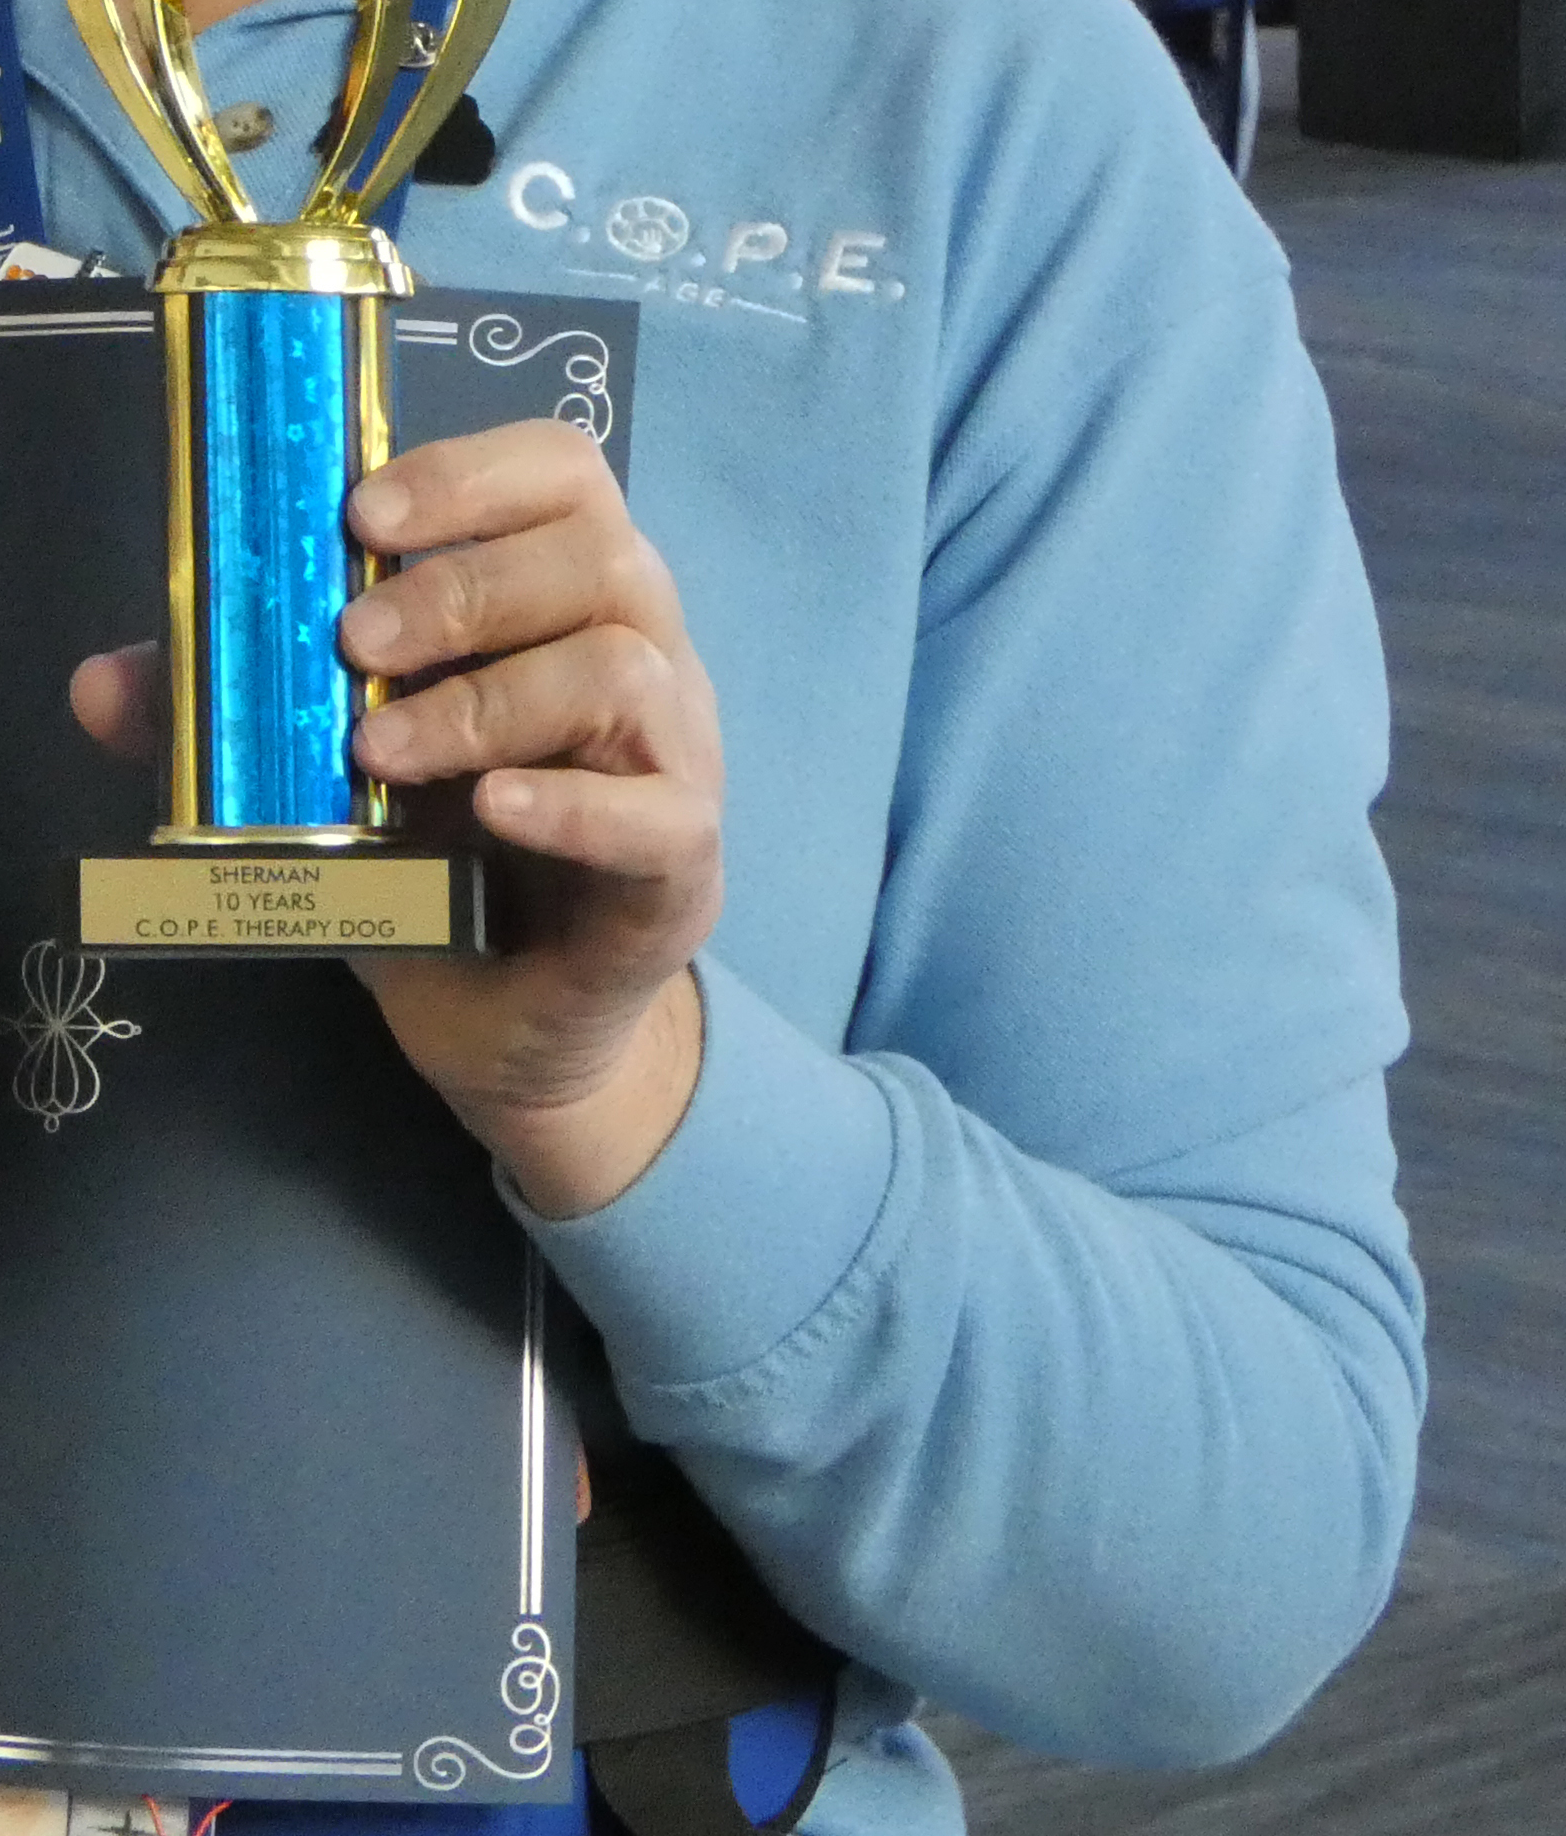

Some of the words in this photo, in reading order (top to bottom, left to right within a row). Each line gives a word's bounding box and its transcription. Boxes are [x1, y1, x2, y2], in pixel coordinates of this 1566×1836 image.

[209, 866, 321, 884] SHERMAN
[213, 893, 240, 911] 10
[249, 892, 316, 912] YEARS
[235, 919, 332, 938] THERAPY
[340, 919, 396, 938] DOG
